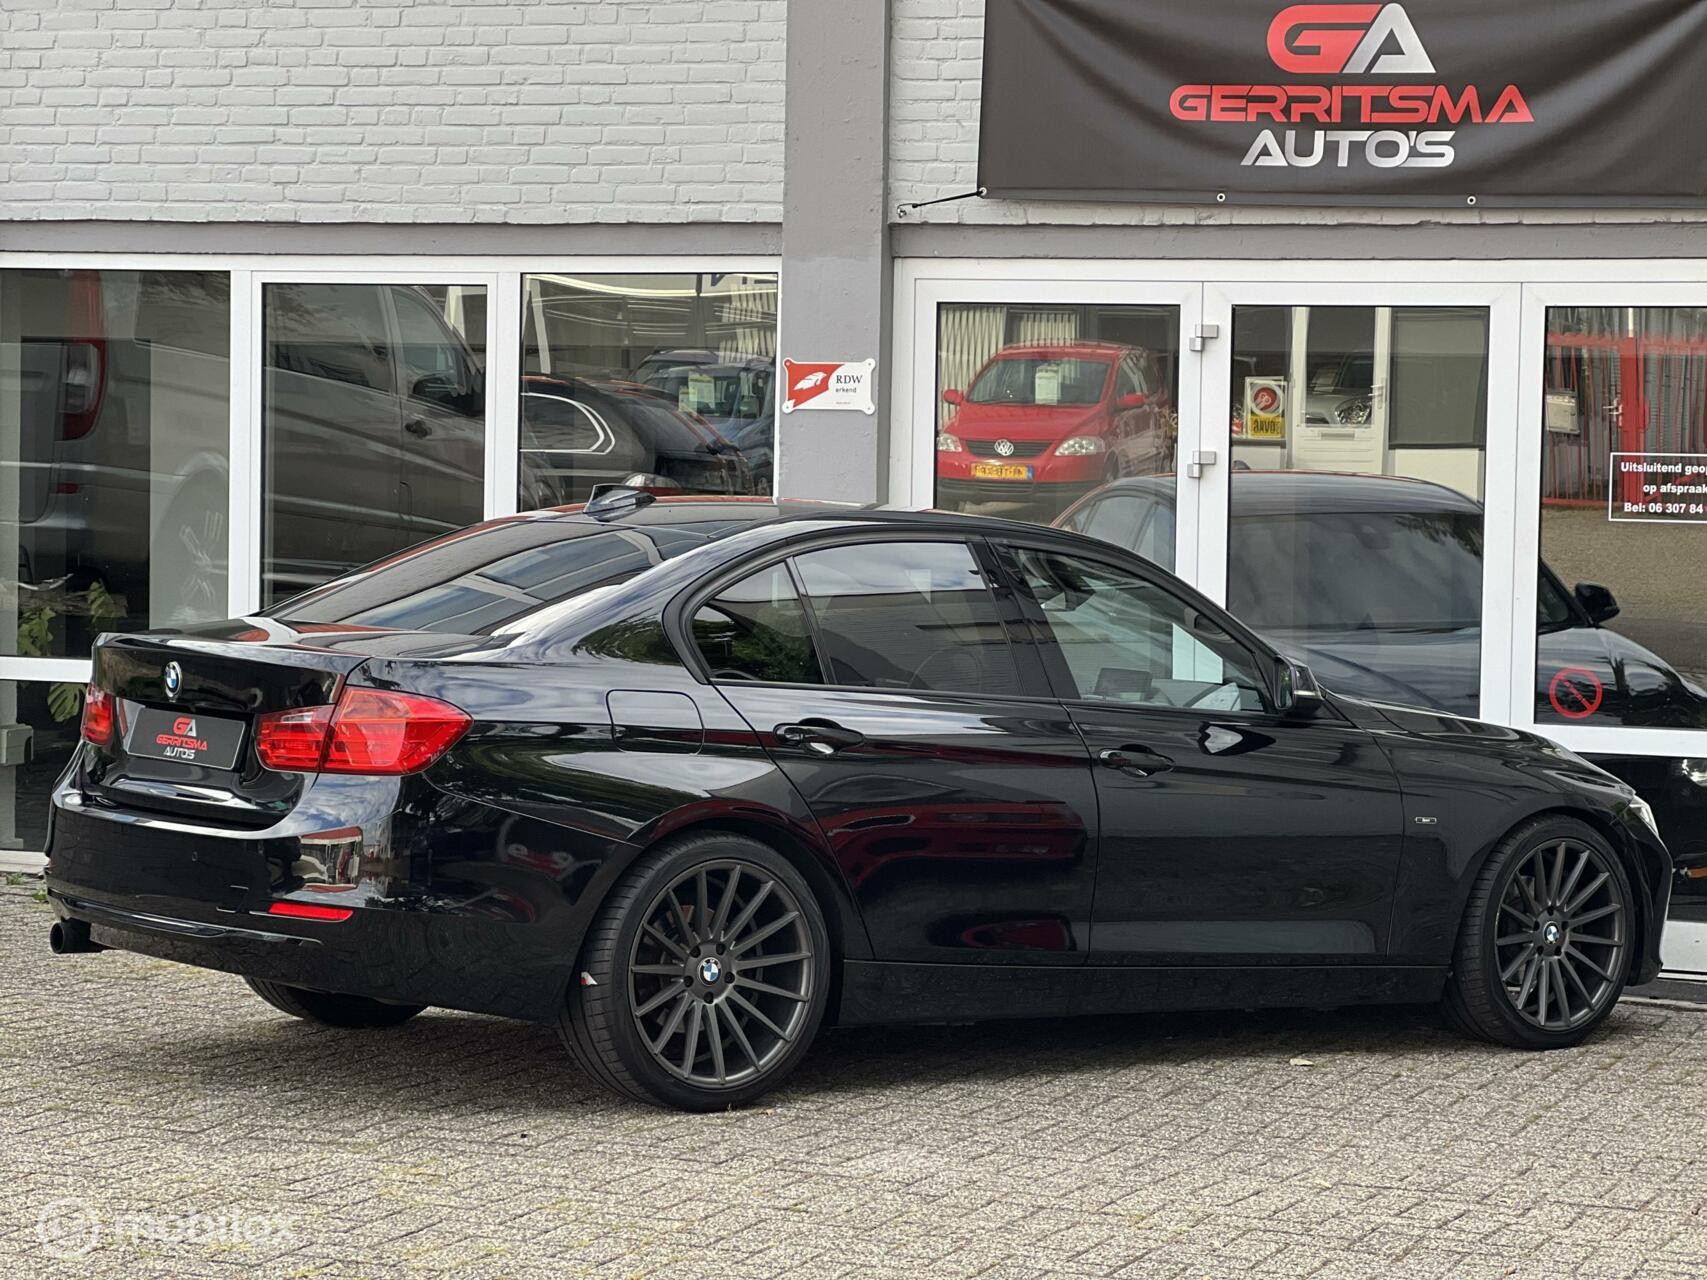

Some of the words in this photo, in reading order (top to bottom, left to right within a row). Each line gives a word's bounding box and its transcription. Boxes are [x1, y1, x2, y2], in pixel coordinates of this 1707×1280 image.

[1266, 2, 1437, 74] GA
[1169, 84, 1535, 124] GERRITSMA
[1240, 129, 1456, 168] AUTO'S
[835, 374, 863, 384] RDW
[1621, 462, 1682, 473] Uitsluitend
[1685, 465, 1707, 476] geo
[1643, 485, 1657, 494] op
[1660, 483, 1707, 495] afspraak
[1624, 503, 1646, 512] Bel:
[1648, 503, 1663, 513] 06
[1665, 503, 1687, 513] 307
[1689, 503, 1704, 514] 84
[173, 717, 197, 736] GA
